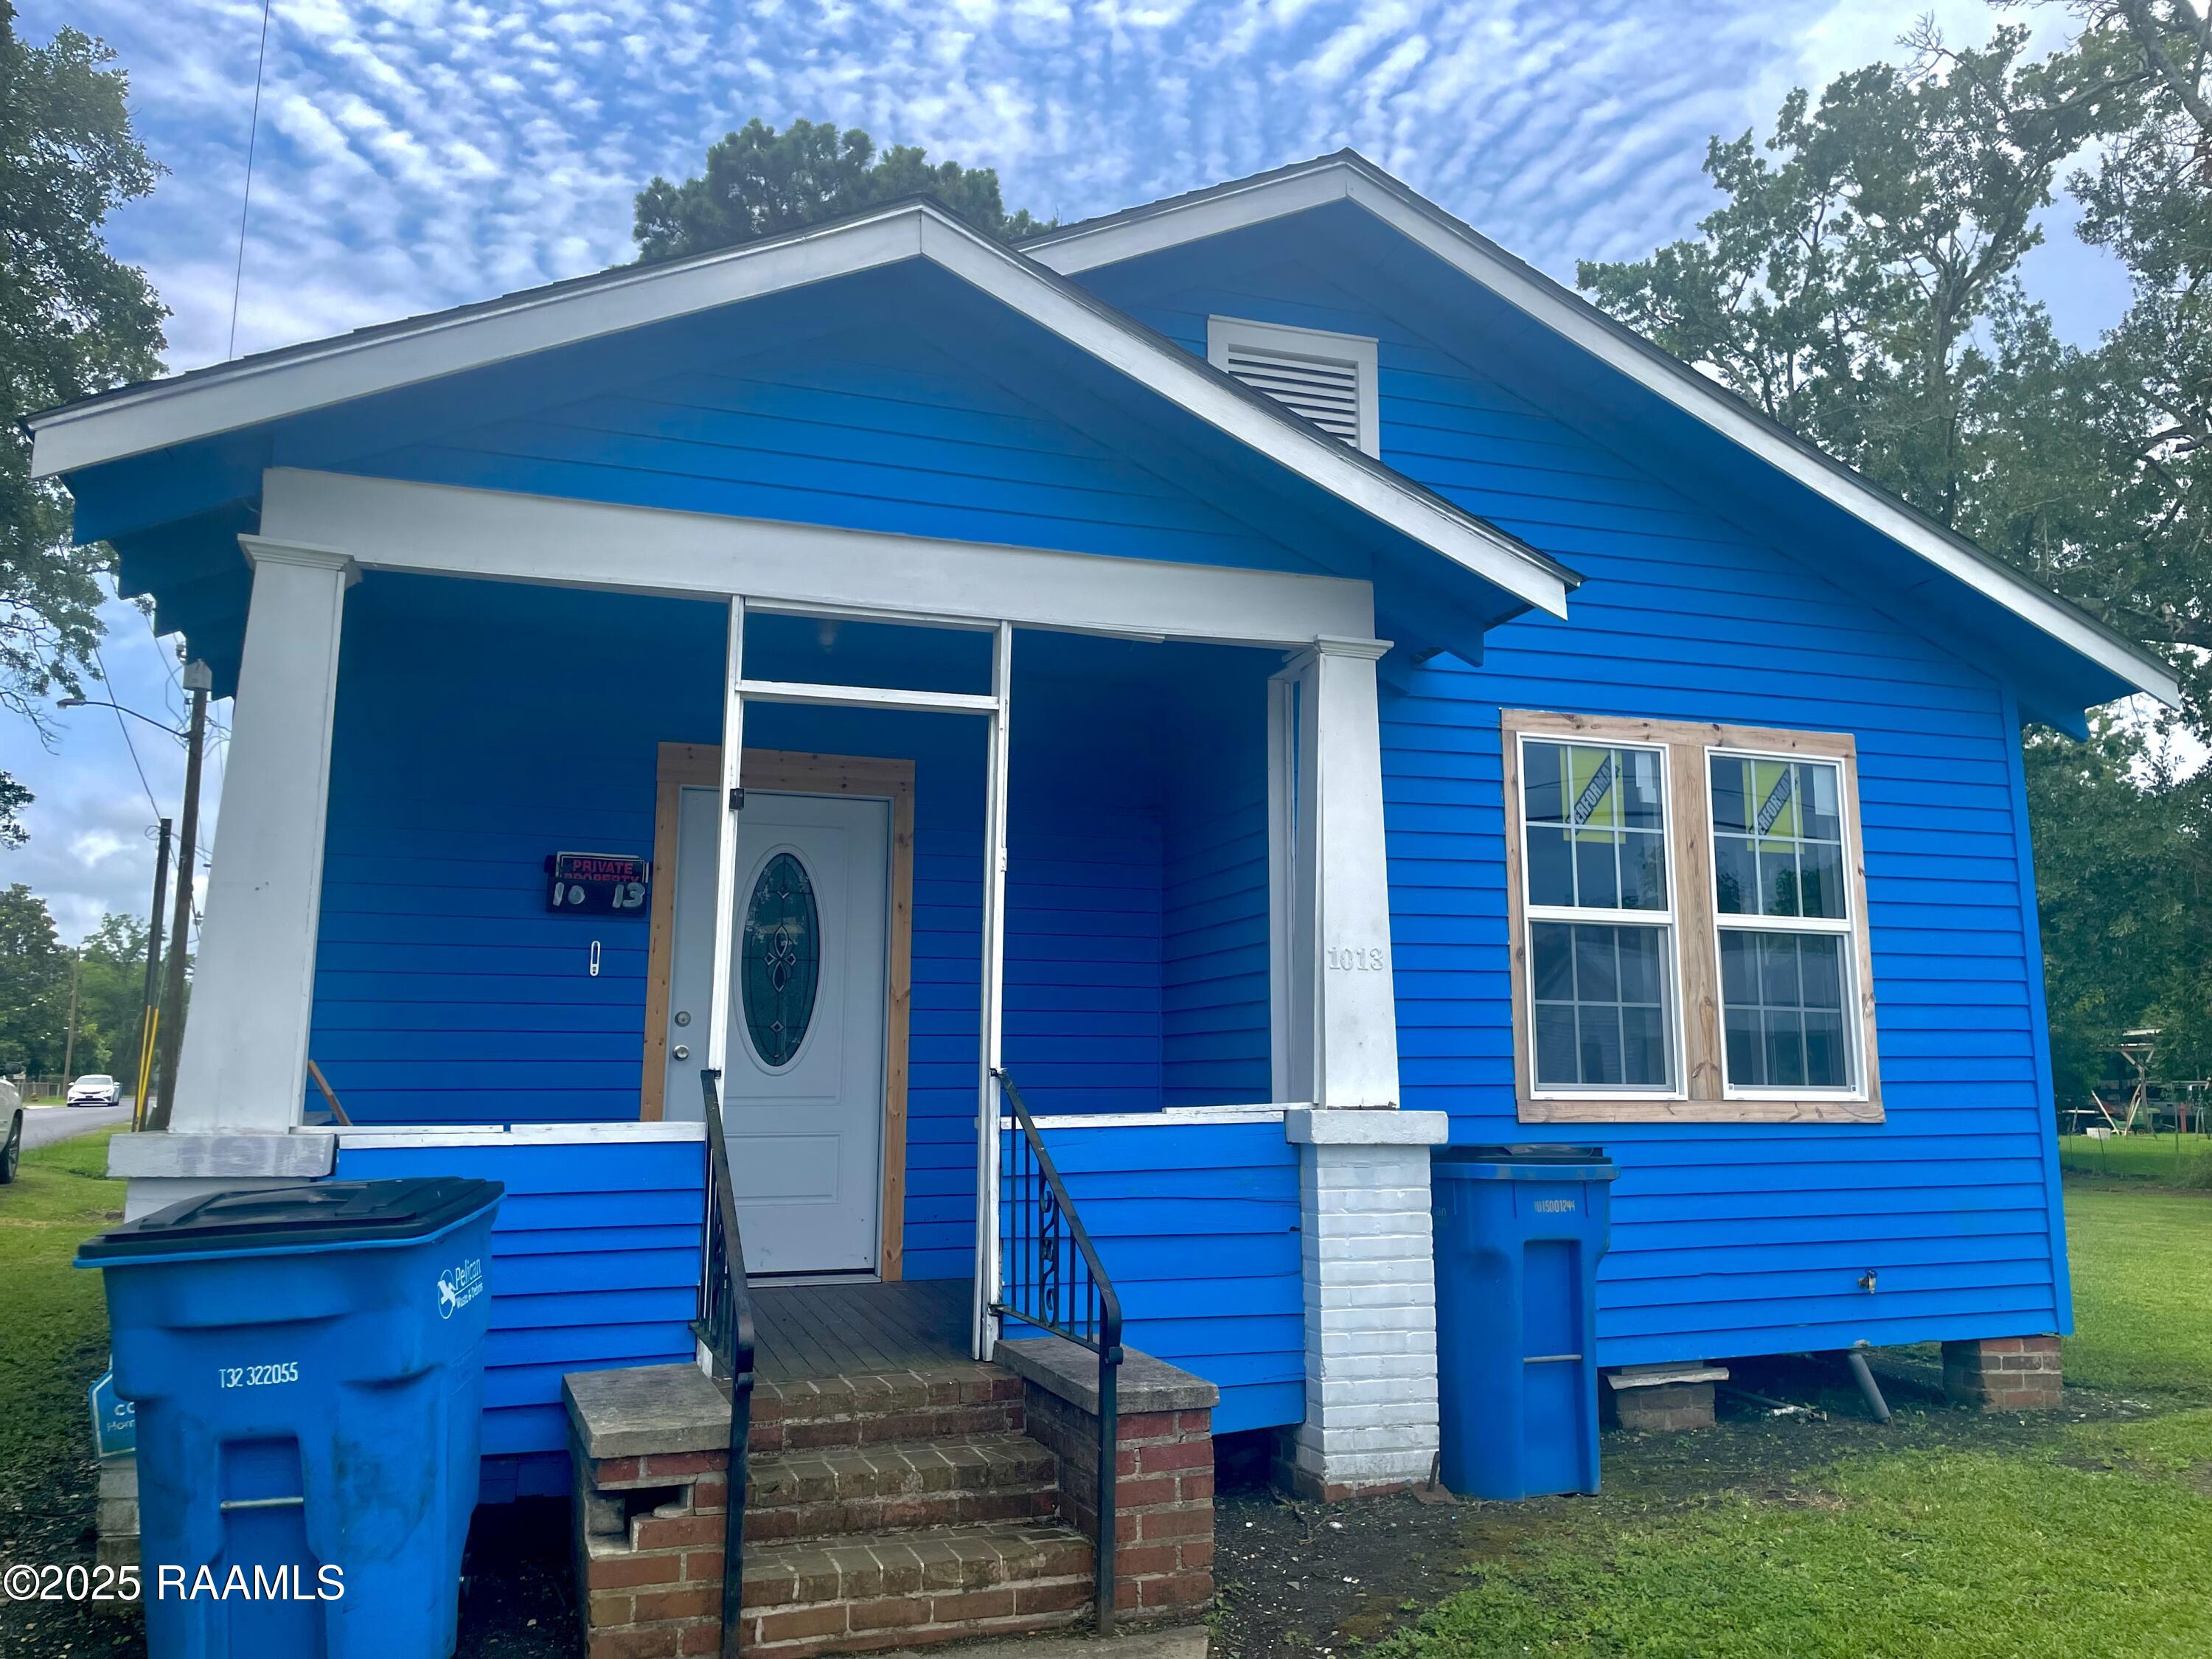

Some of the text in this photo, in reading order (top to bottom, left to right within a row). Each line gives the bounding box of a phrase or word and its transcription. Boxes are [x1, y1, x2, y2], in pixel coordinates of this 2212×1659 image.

[572, 860, 633, 874] PRIVATE
[1327, 947, 1384, 971] 1013
[455, 1258, 481, 1291] Pelican
[218, 1361, 299, 1388] T32 322055
[114, 1402, 136, 1416] CO
